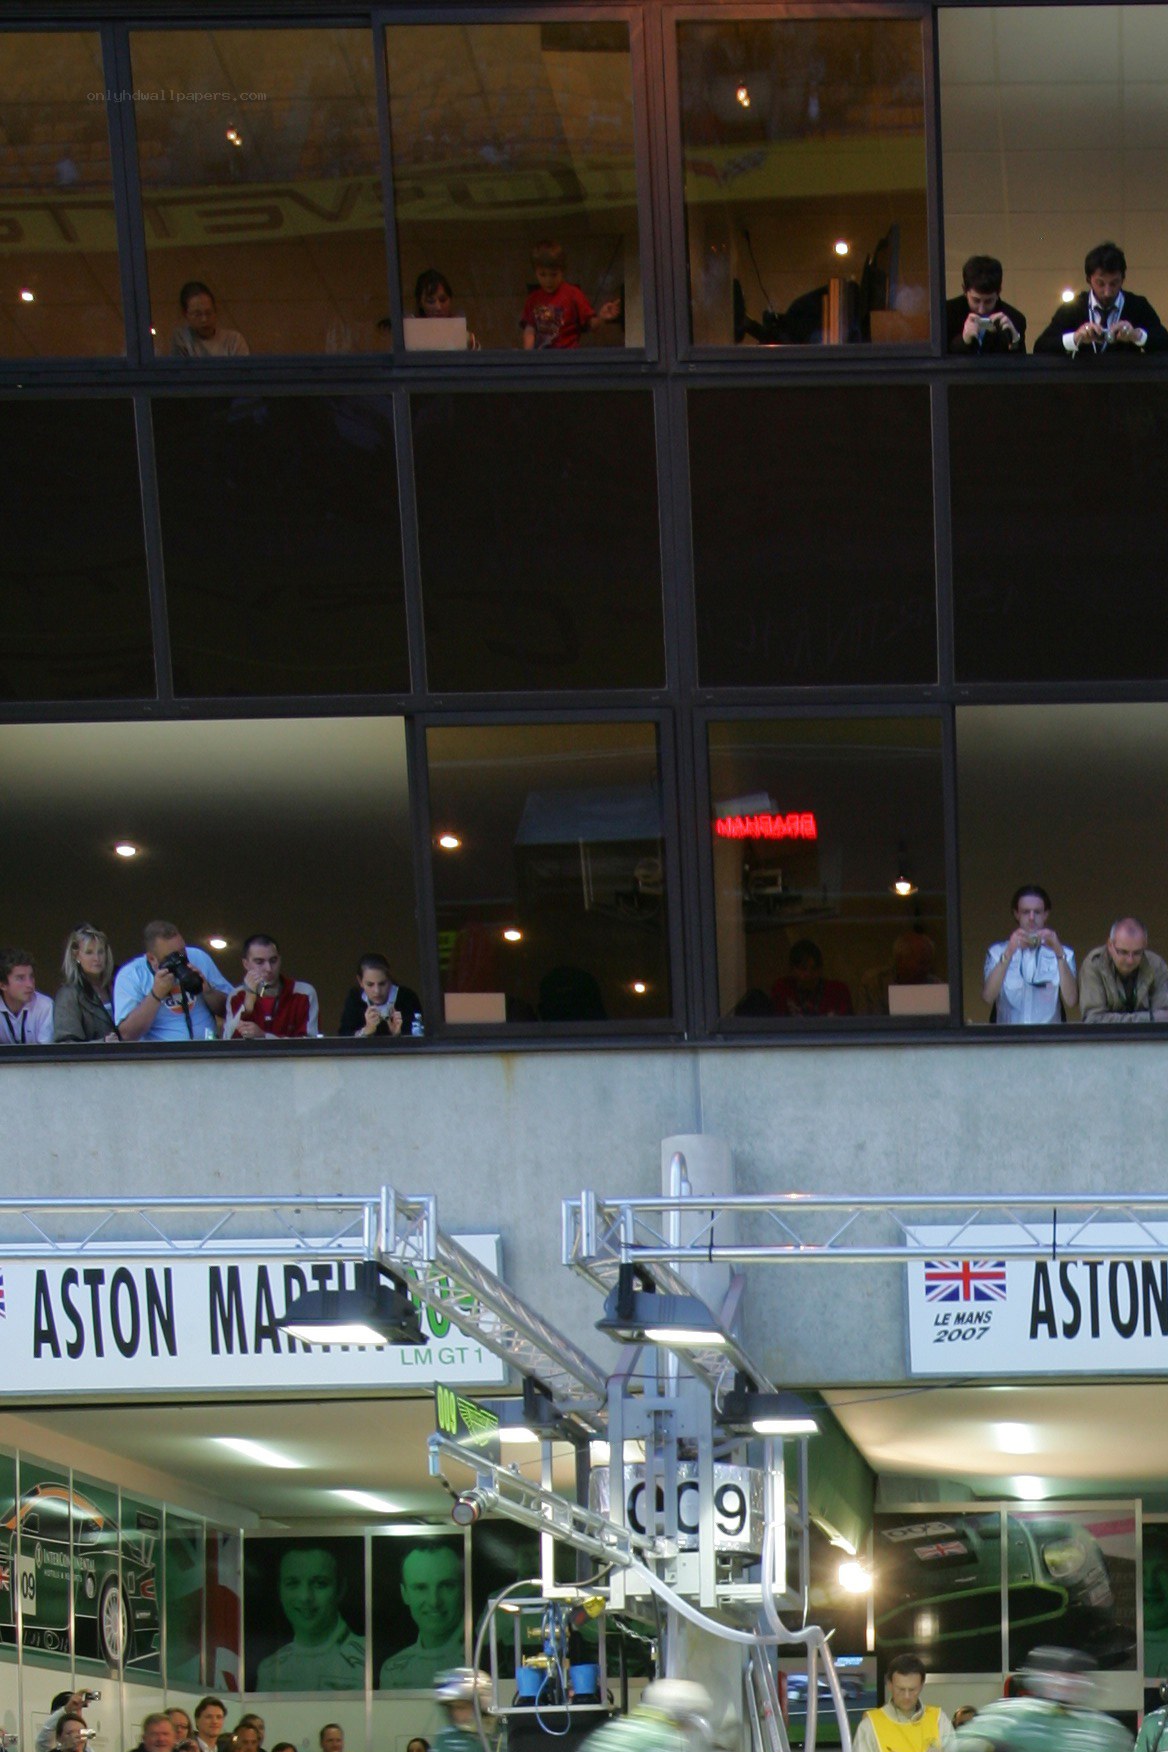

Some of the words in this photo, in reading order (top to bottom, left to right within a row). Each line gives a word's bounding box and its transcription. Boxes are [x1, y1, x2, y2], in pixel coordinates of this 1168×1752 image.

[33, 1266, 178, 1359] ASTON
[933, 1312, 950, 1326] LE
[953, 1310, 993, 1325] MANS
[932, 1326, 991, 1344] 2007
